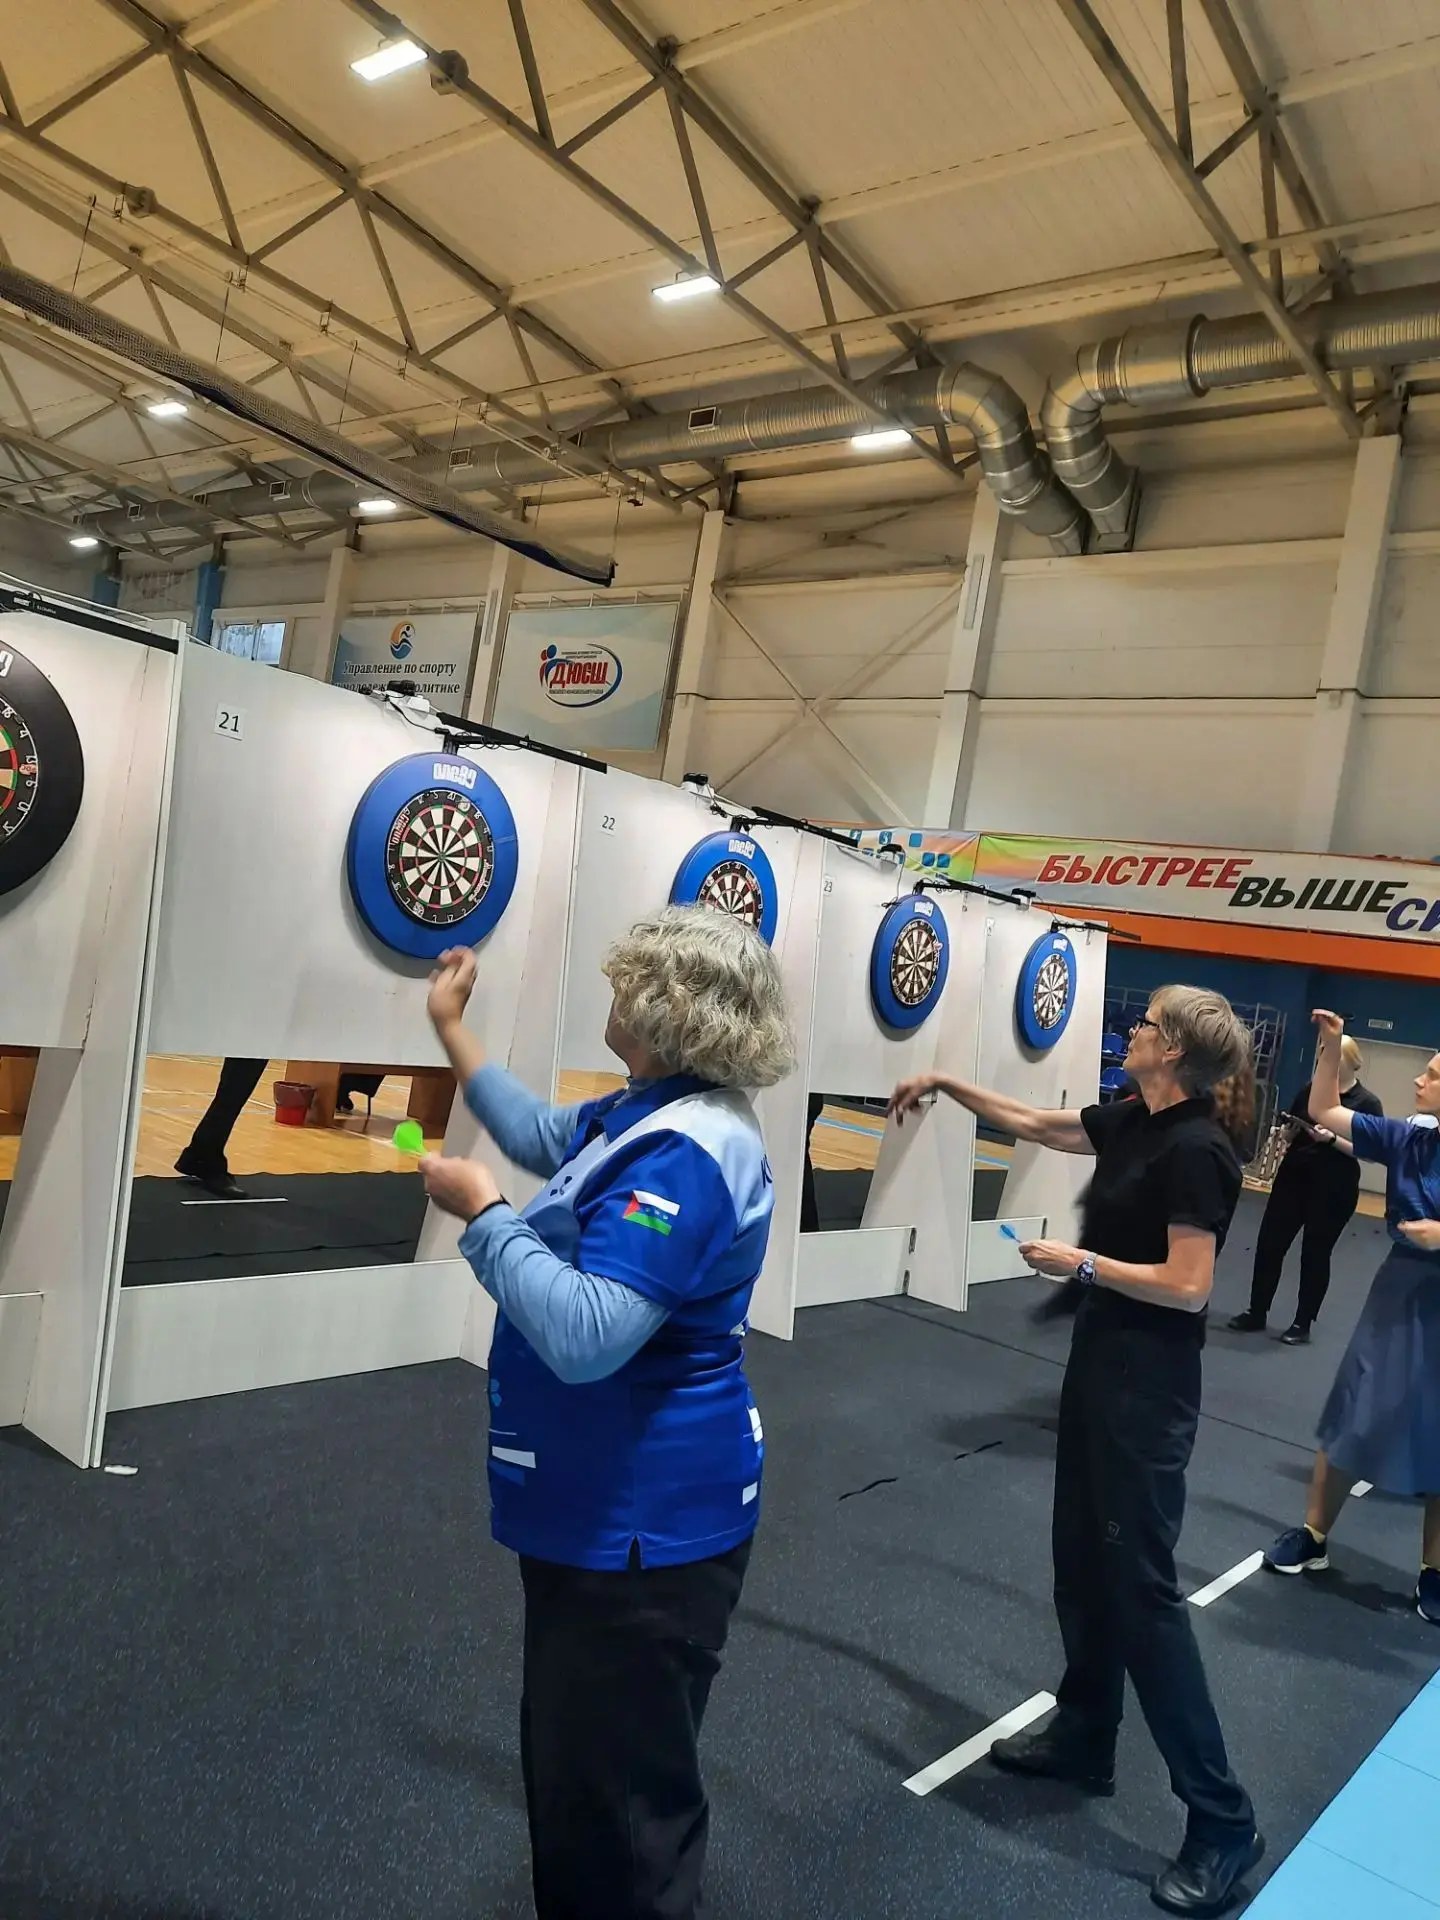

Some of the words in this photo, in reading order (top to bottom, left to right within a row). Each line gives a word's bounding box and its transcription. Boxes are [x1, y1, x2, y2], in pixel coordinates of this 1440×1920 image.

[342, 662, 401, 676] Управление
[403, 664, 418, 674] по
[418, 663, 457, 677] спорту
[549, 661, 609, 689] ДЮСШ
[414, 682, 460, 693] олитике
[218, 711, 239, 732] 21
[602, 815, 615, 831] 22
[824, 880, 833, 893] 23
[1036, 855, 1253, 889] БЫСТРЕЕ
[1228, 876, 1409, 912] ВЫШЕ
